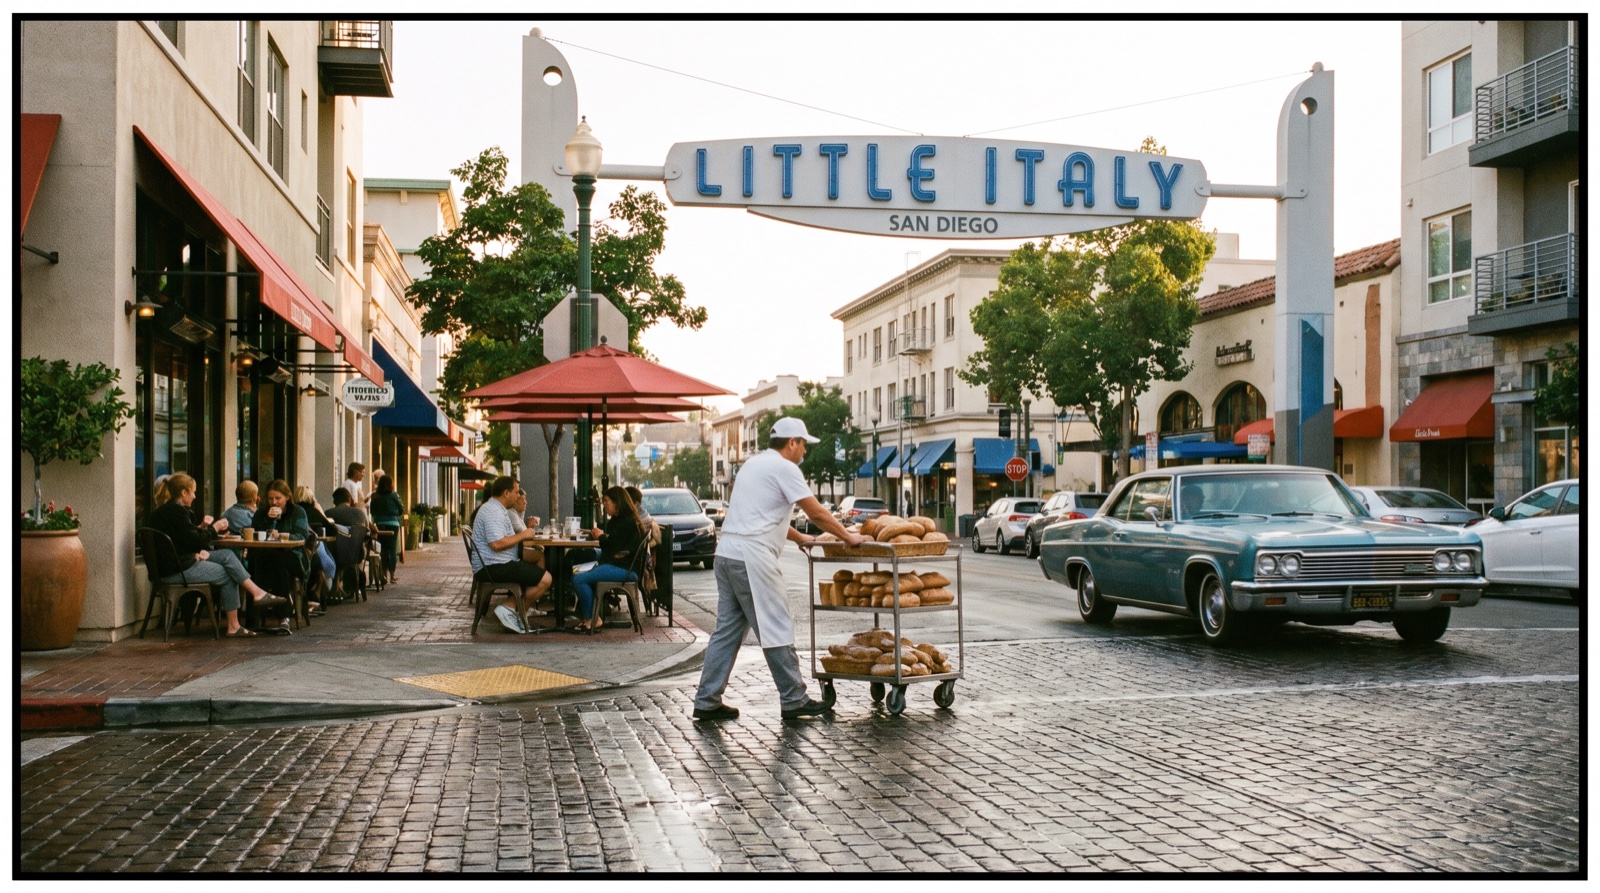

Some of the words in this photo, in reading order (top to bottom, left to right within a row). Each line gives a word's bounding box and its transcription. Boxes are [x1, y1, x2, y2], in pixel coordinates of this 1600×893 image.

[696, 143, 936, 203] LITTLE
[985, 147, 1184, 210] ITALY
[889, 214, 929, 232] SAN
[937, 216, 998, 234] DIEGO
[1007, 464, 1027, 474] STOP
